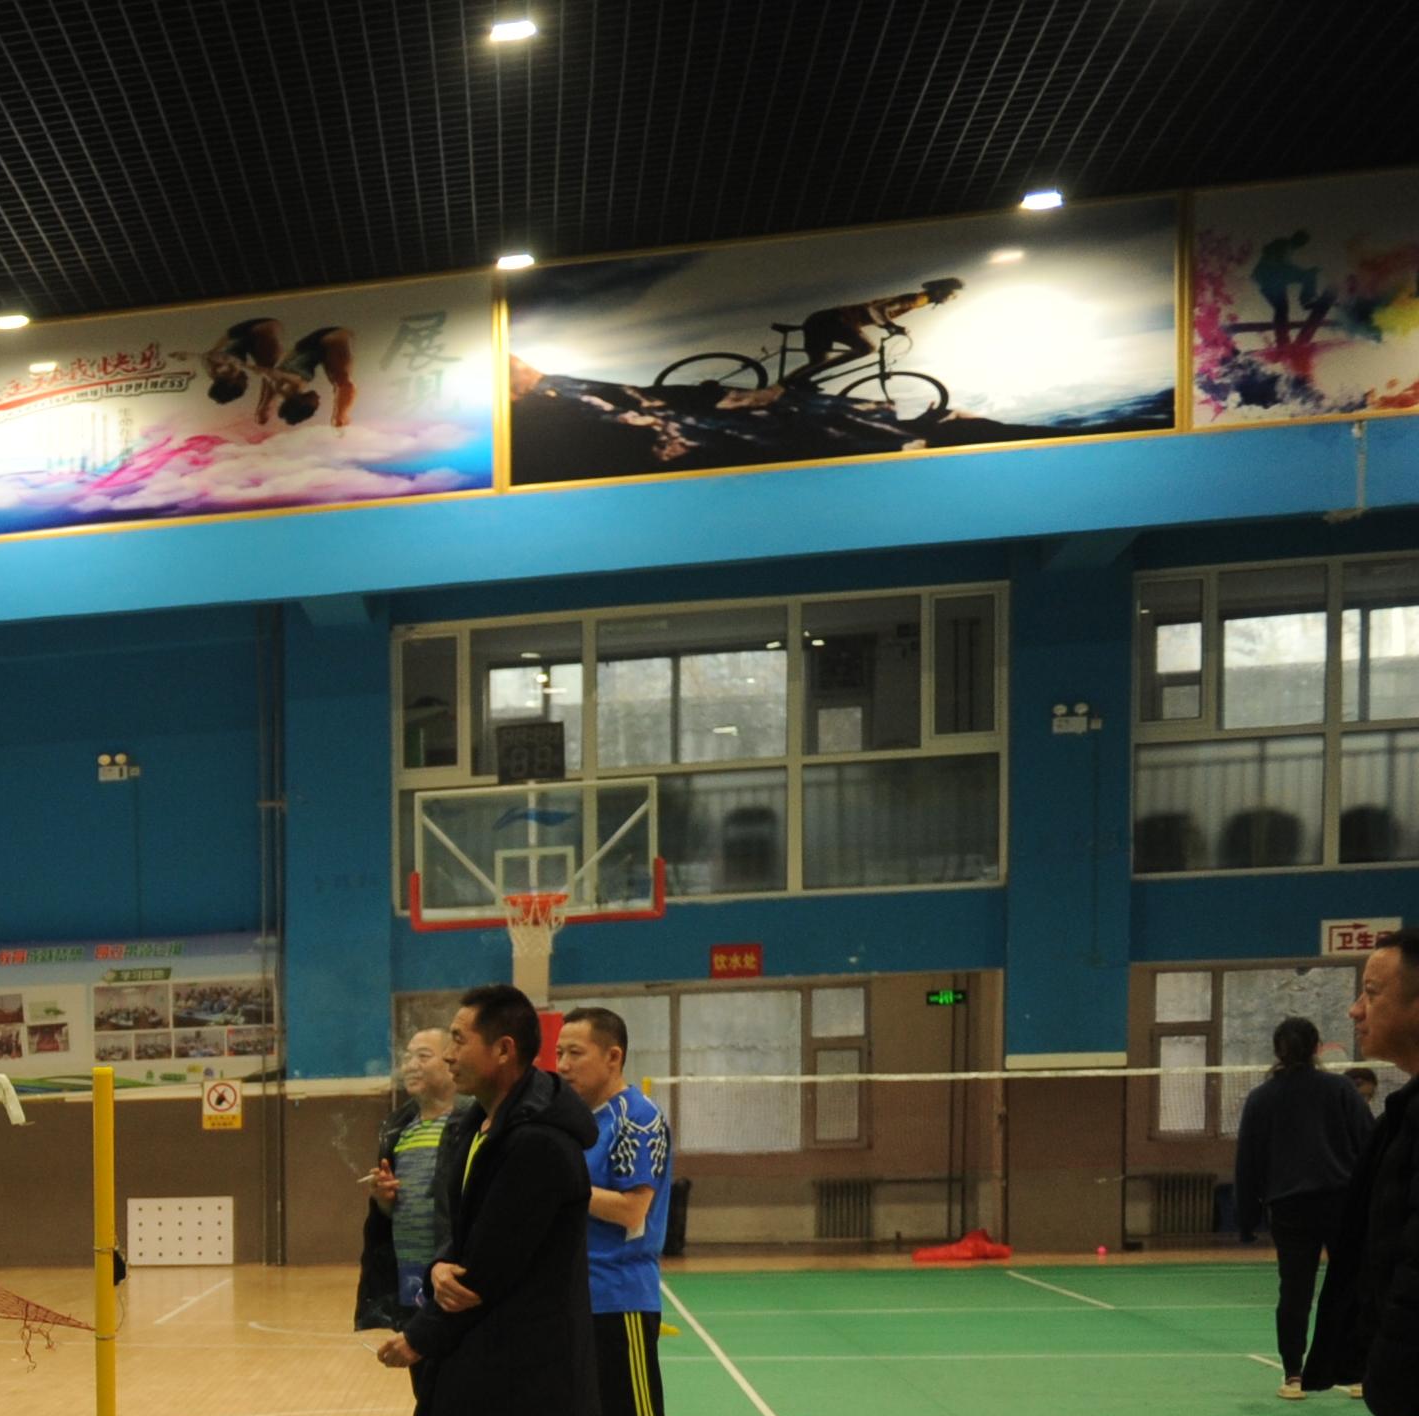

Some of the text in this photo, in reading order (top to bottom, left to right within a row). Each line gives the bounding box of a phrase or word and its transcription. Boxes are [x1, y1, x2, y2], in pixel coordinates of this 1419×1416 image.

[105, 379, 185, 396] happiness
[713, 953, 757, 971] 饮水处
